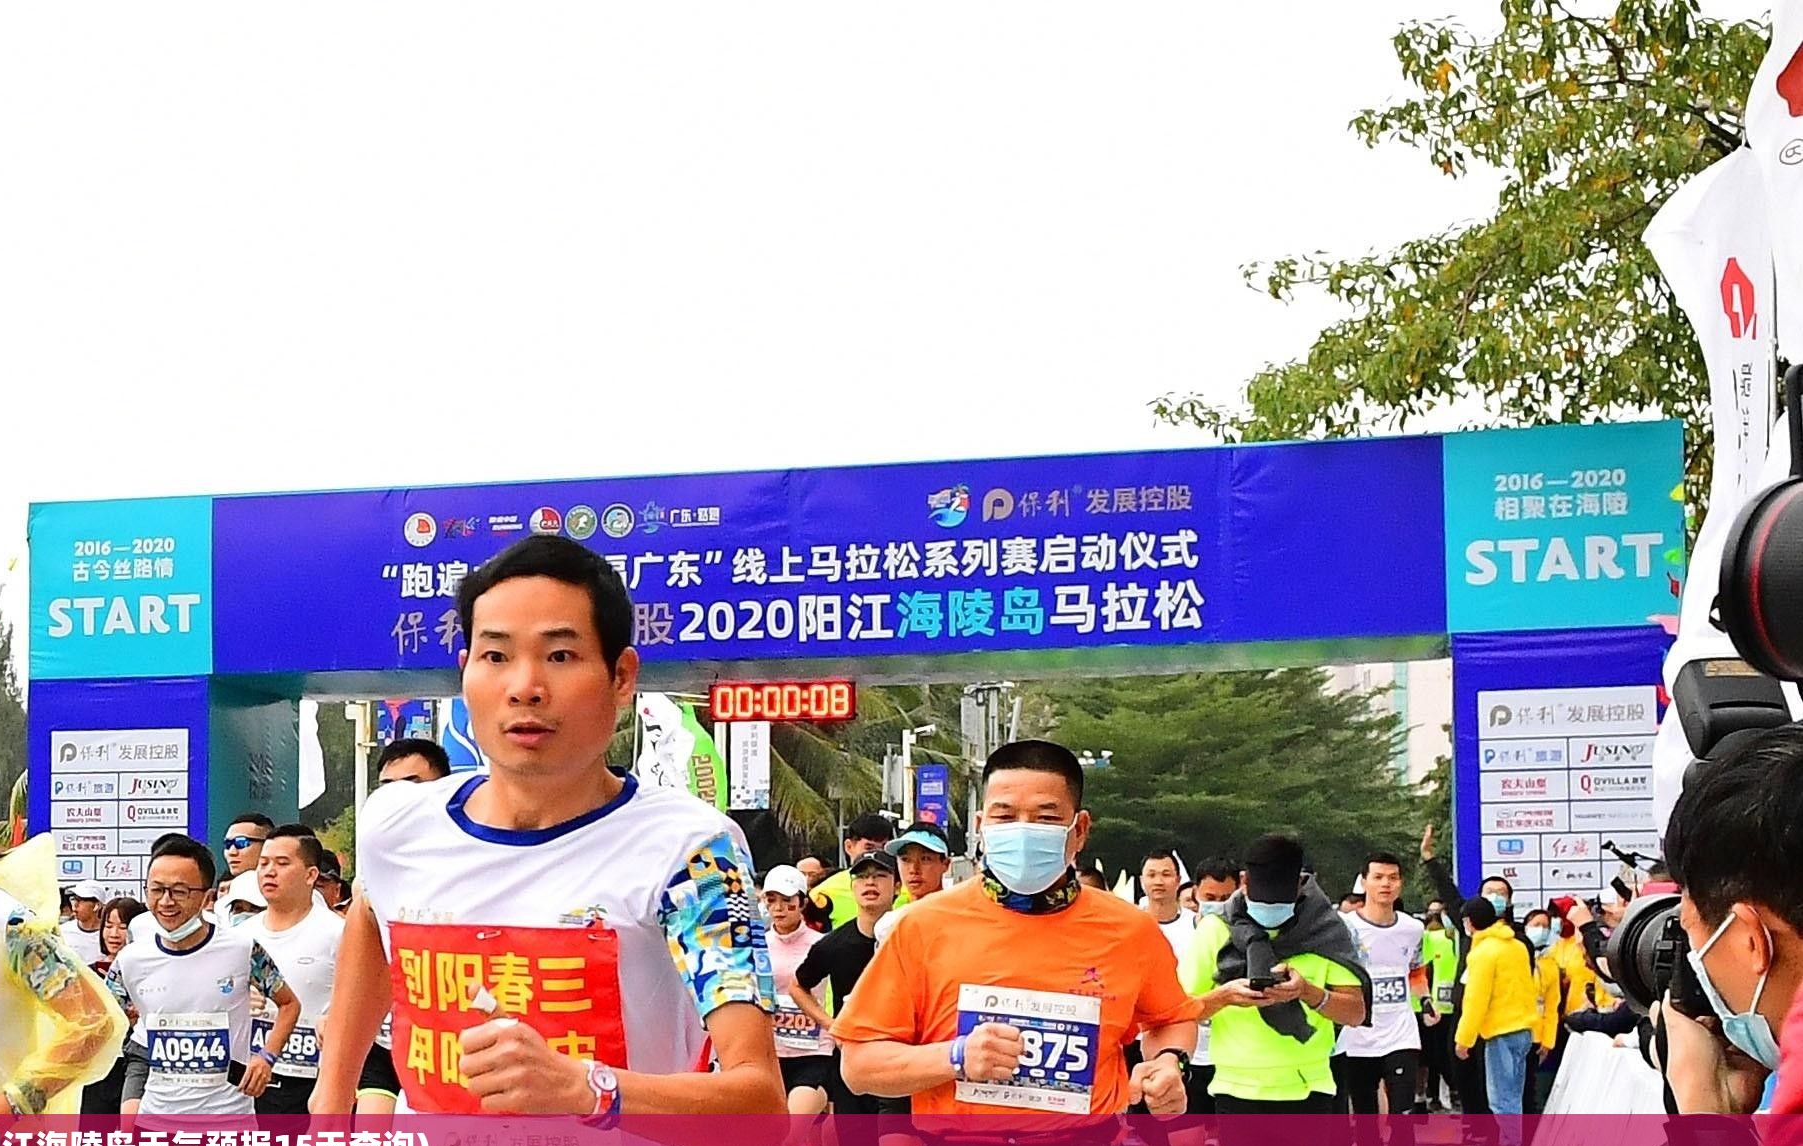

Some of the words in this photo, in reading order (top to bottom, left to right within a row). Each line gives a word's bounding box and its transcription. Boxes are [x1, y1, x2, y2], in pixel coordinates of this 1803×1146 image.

[1495, 490, 1629, 521] 相聚在海陵
[1464, 532, 1665, 586] START
[47, 593, 202, 638] START
[714, 684, 850, 718] 00:00:08
[151, 1036, 227, 1063] A0944
